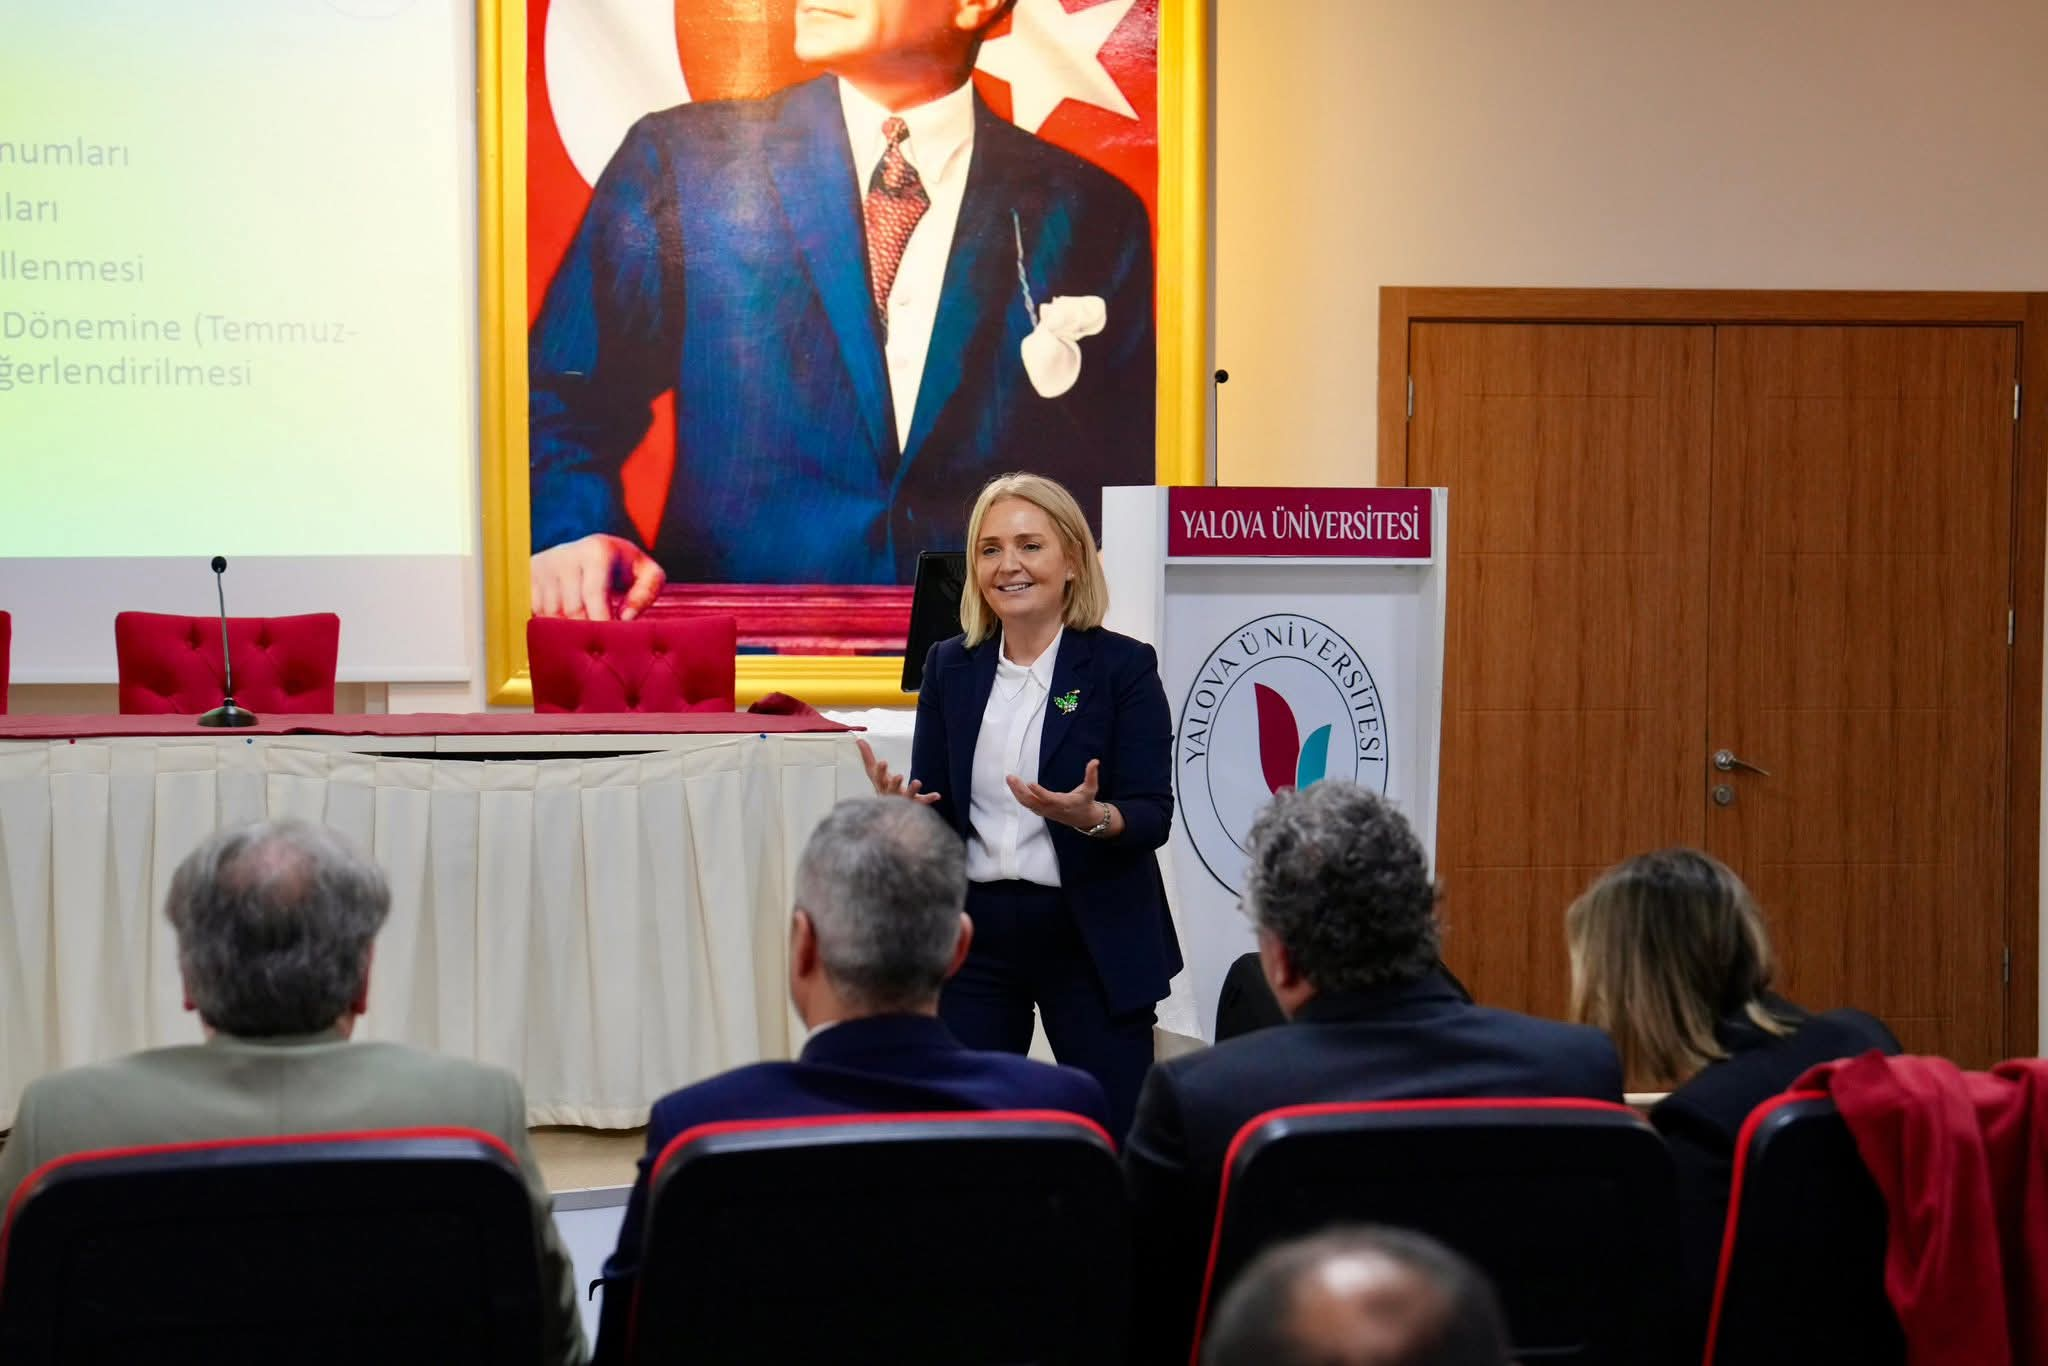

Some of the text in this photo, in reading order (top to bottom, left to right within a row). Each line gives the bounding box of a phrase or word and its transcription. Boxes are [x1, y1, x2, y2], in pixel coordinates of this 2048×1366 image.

[0, 136, 129, 167] numları
[0, 192, 58, 222] ları
[1, 250, 144, 282] llenmesi
[3, 312, 360, 349] Dönemine (Temmuz-
[0, 355, 252, 391] ğerlendirilmesi
[1180, 504, 1420, 541] YALOVA ÜNİVERSİTESİ
[1186, 621, 1384, 764] YALOVA ÜNİVERSİTESİ
